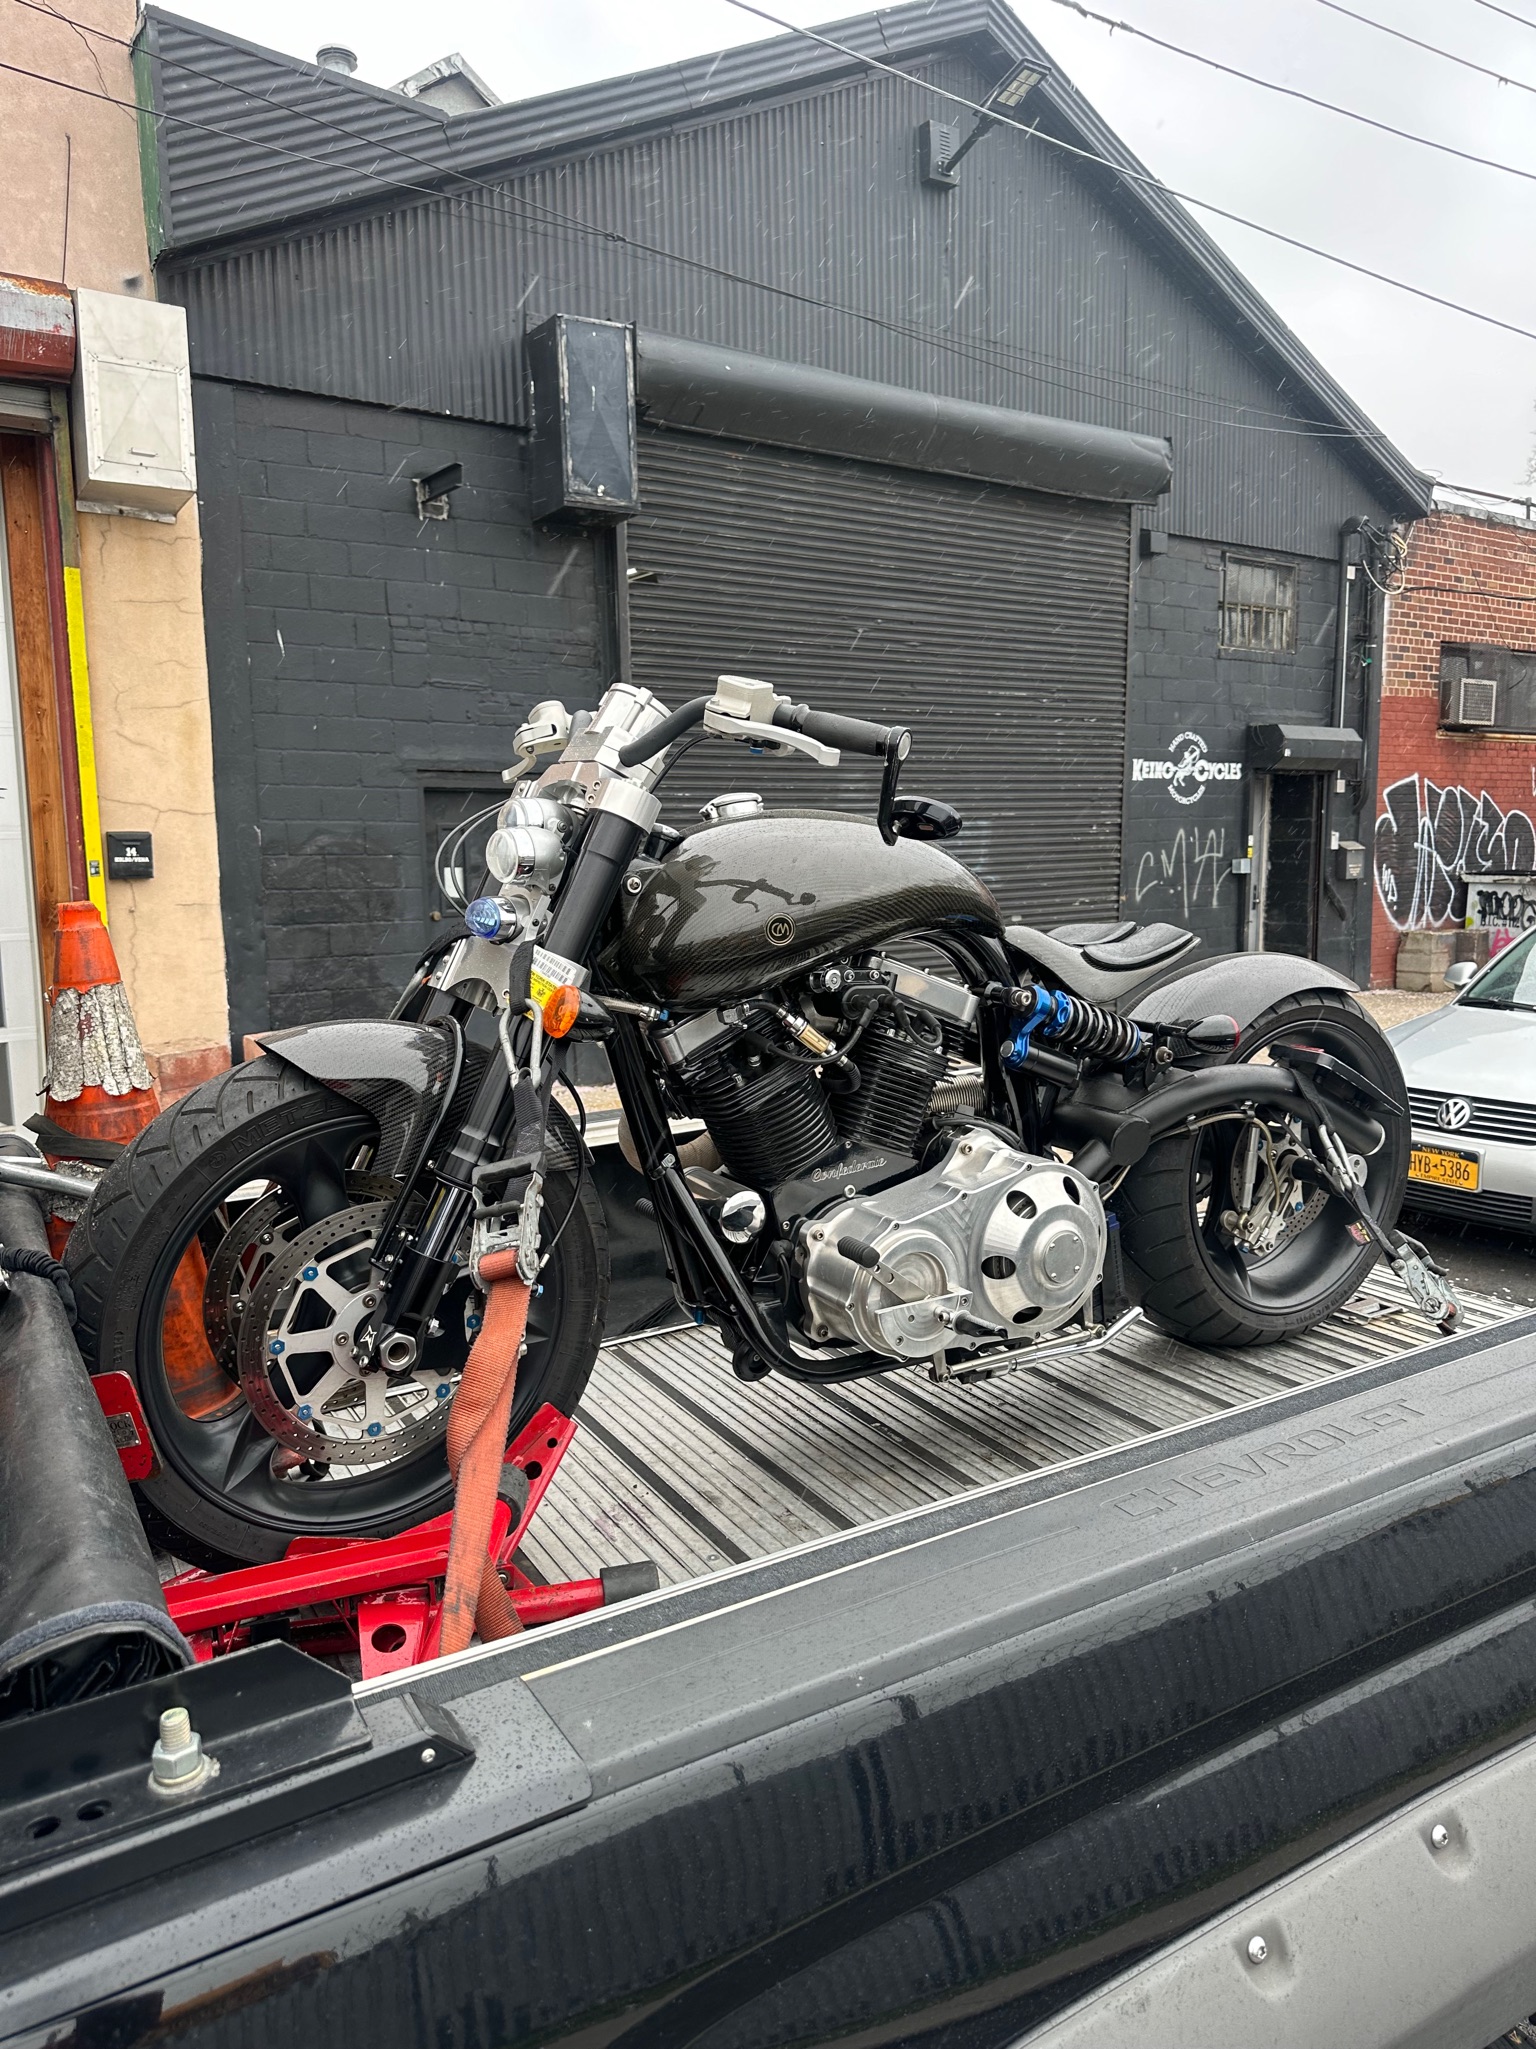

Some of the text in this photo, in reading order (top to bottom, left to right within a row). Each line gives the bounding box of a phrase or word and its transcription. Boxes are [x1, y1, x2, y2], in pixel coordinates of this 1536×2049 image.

[1168, 731, 1208, 753] HAND CRAFTED
[1193, 759, 1242, 782] CYCLES
[230, 1100, 345, 1153] METZE
[1422, 1146, 1460, 1158] NEW YORK
[811, 1156, 887, 1182] Confederate
[1420, 1173, 1458, 1184] EMPIRE STATE
[1440, 1158, 1470, 1181] 5386
[109, 1420, 132, 1431] OCK
[1101, 1398, 1425, 1522] CHEVROLET
